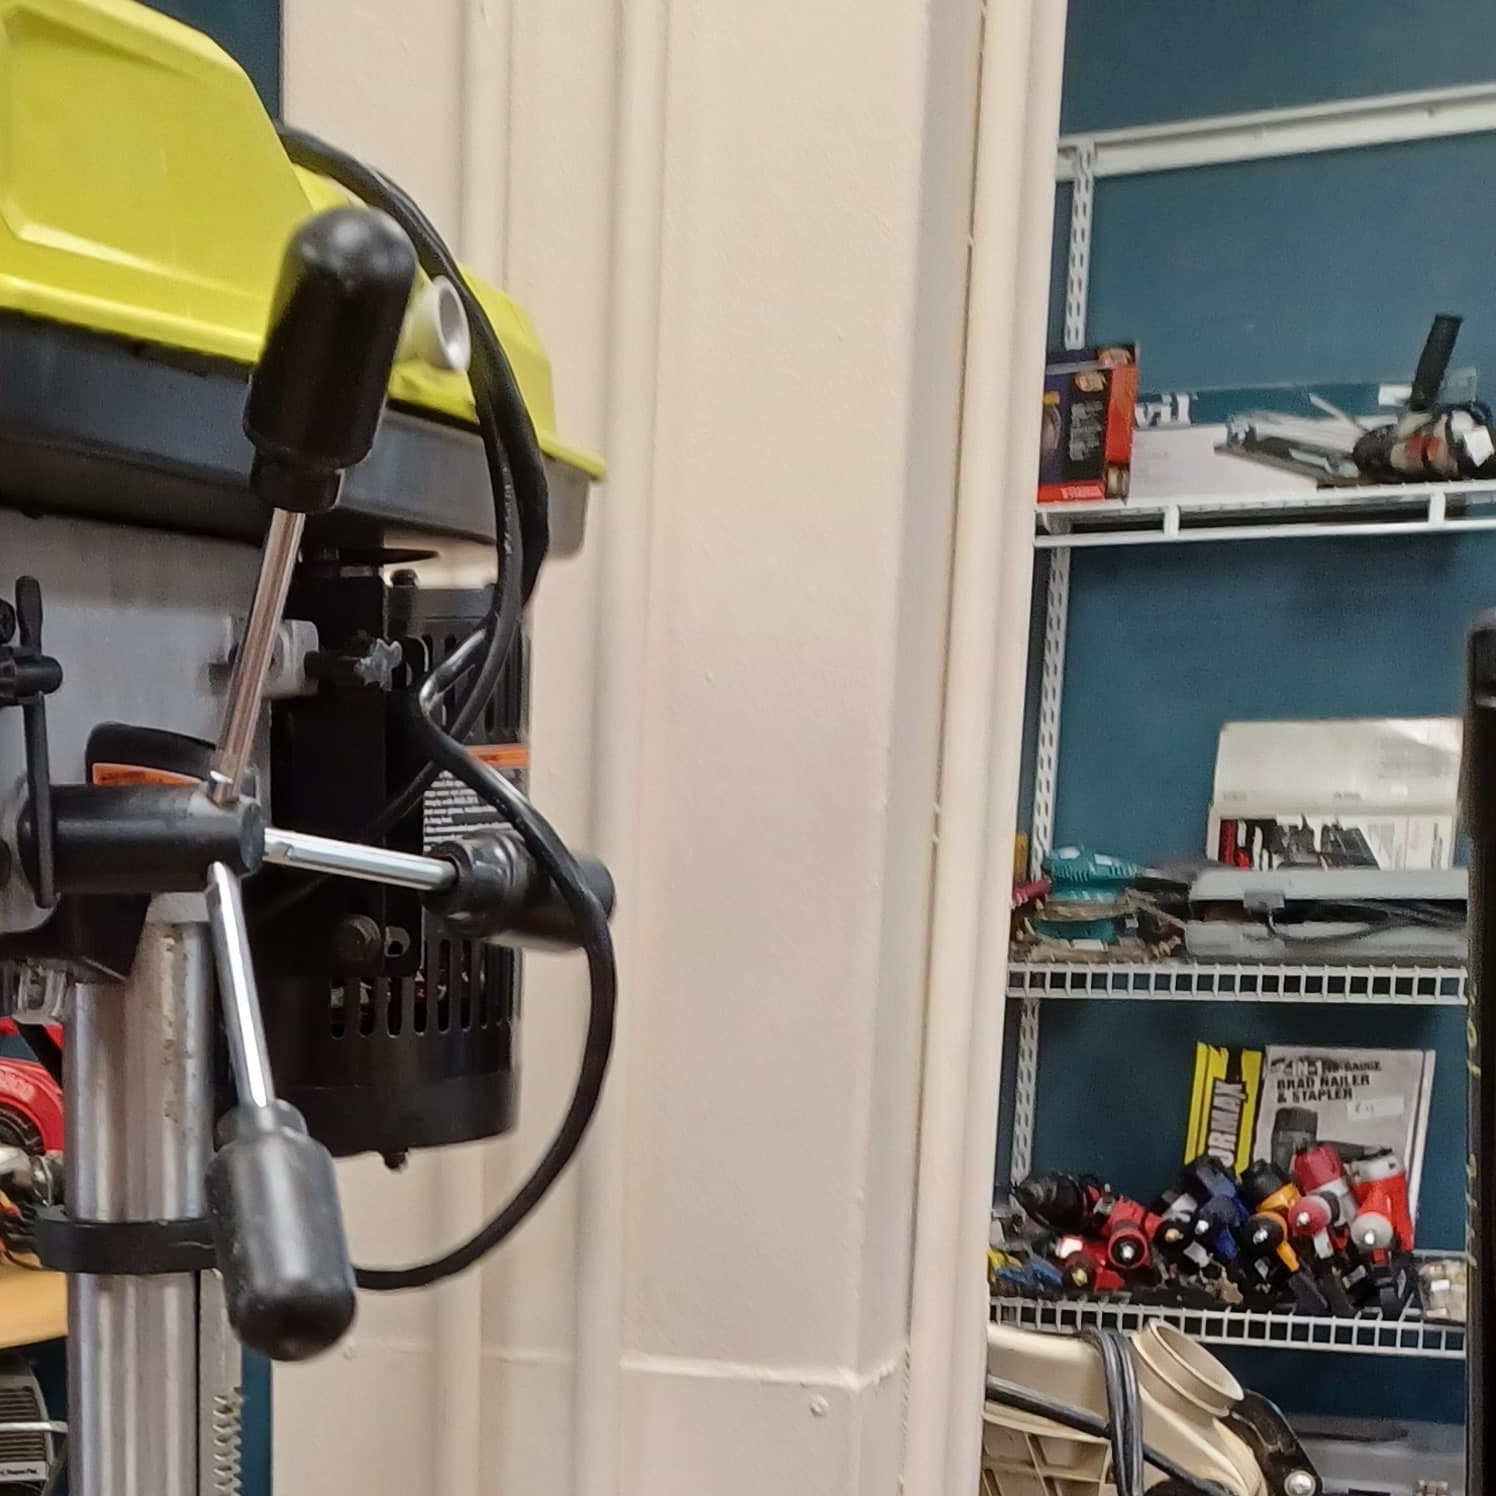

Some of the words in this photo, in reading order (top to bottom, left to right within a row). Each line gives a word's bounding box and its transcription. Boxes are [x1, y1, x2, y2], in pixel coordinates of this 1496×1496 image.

[1277, 1076, 1315, 1091] BRAD
[1320, 1074, 1370, 1088] NAILER
[1292, 1087, 1352, 1103] STAPLER
